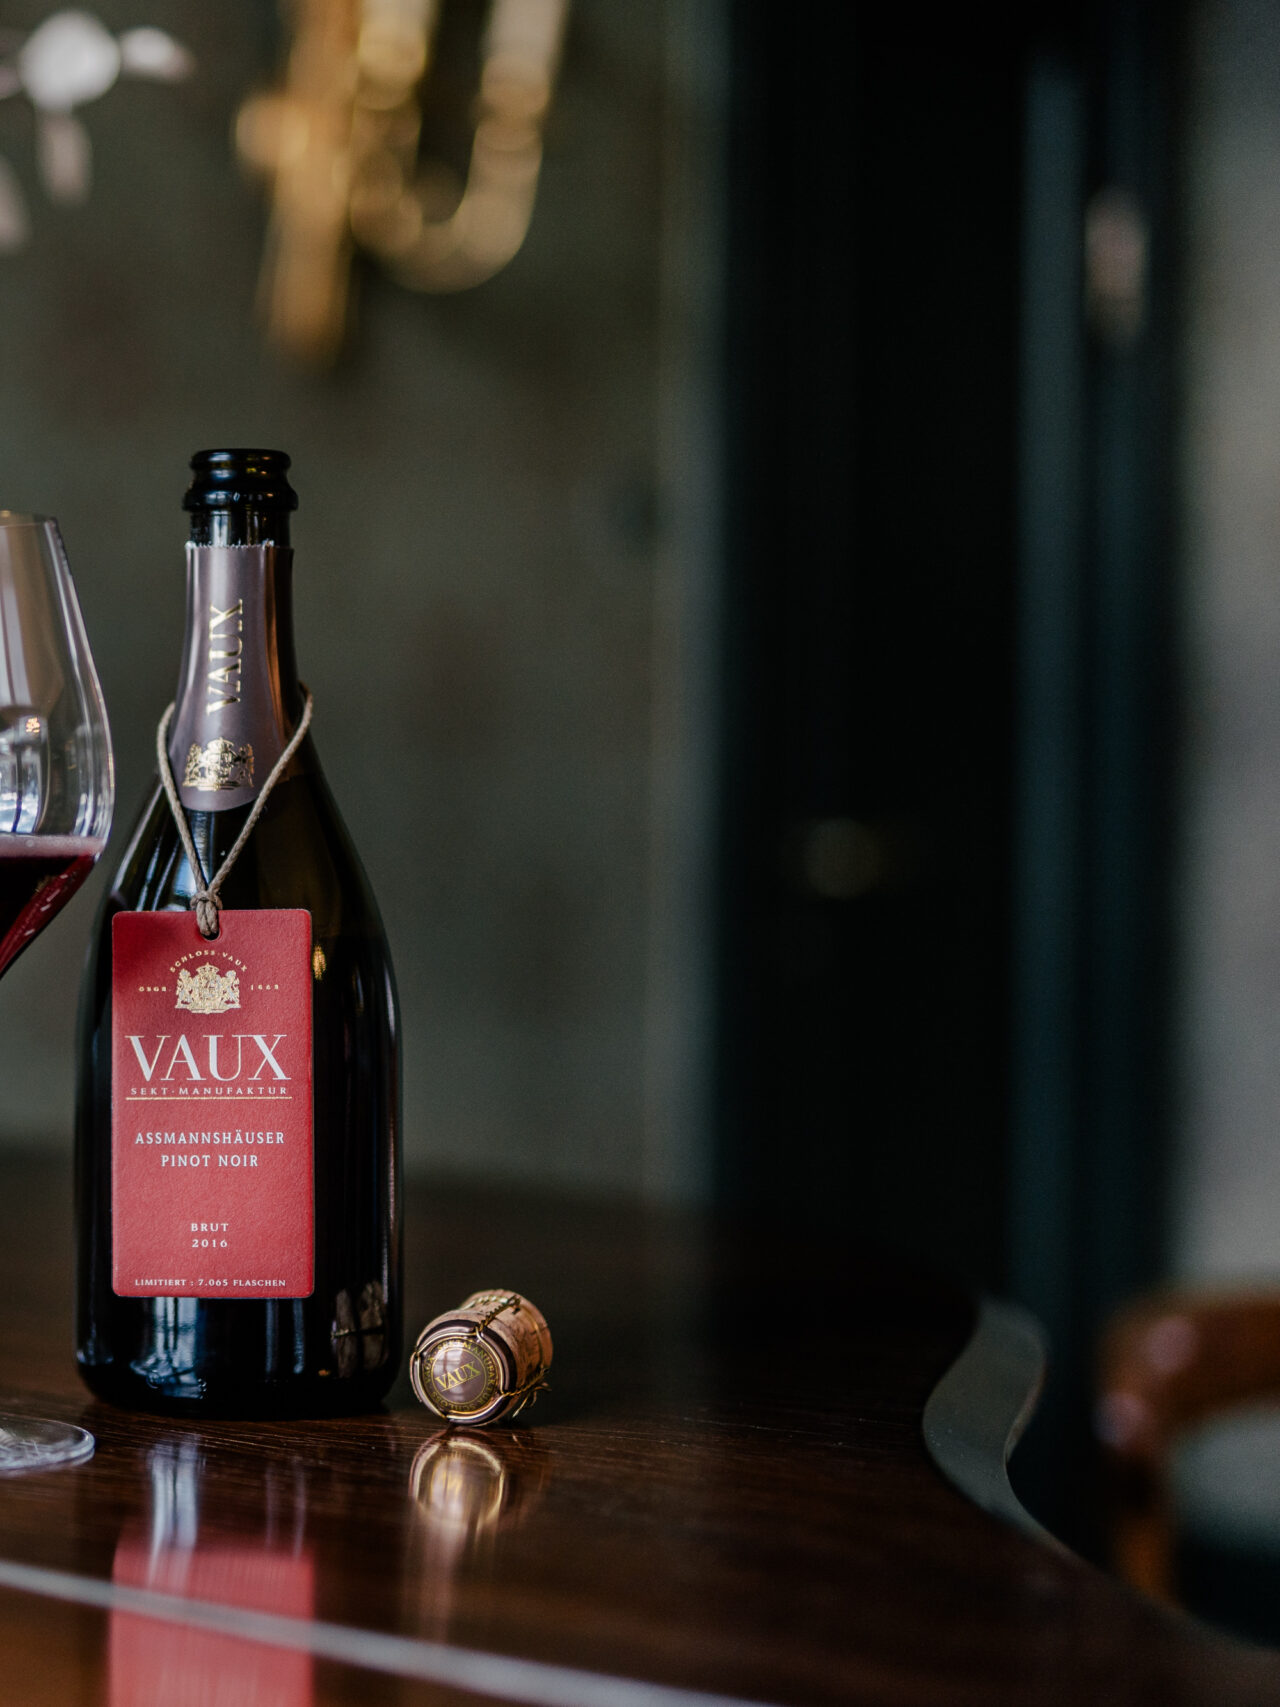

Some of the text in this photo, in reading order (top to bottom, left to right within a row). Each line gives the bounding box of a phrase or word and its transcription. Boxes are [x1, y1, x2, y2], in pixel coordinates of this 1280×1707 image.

[206, 598, 243, 716] VAUX
[222, 952, 248, 972] VAUX
[125, 1034, 292, 1082] VAUX
[135, 1130, 285, 1144] ASSMANNSHÄUSER
[161, 1154, 258, 1167] PINOT NOIR
[191, 1223, 229, 1232] BRUT
[191, 1239, 228, 1248] 2016
[198, 1279, 228, 1287] 7.065
[233, 1279, 286, 1287] FLASCHEN
[435, 1361, 481, 1390] VAUX
